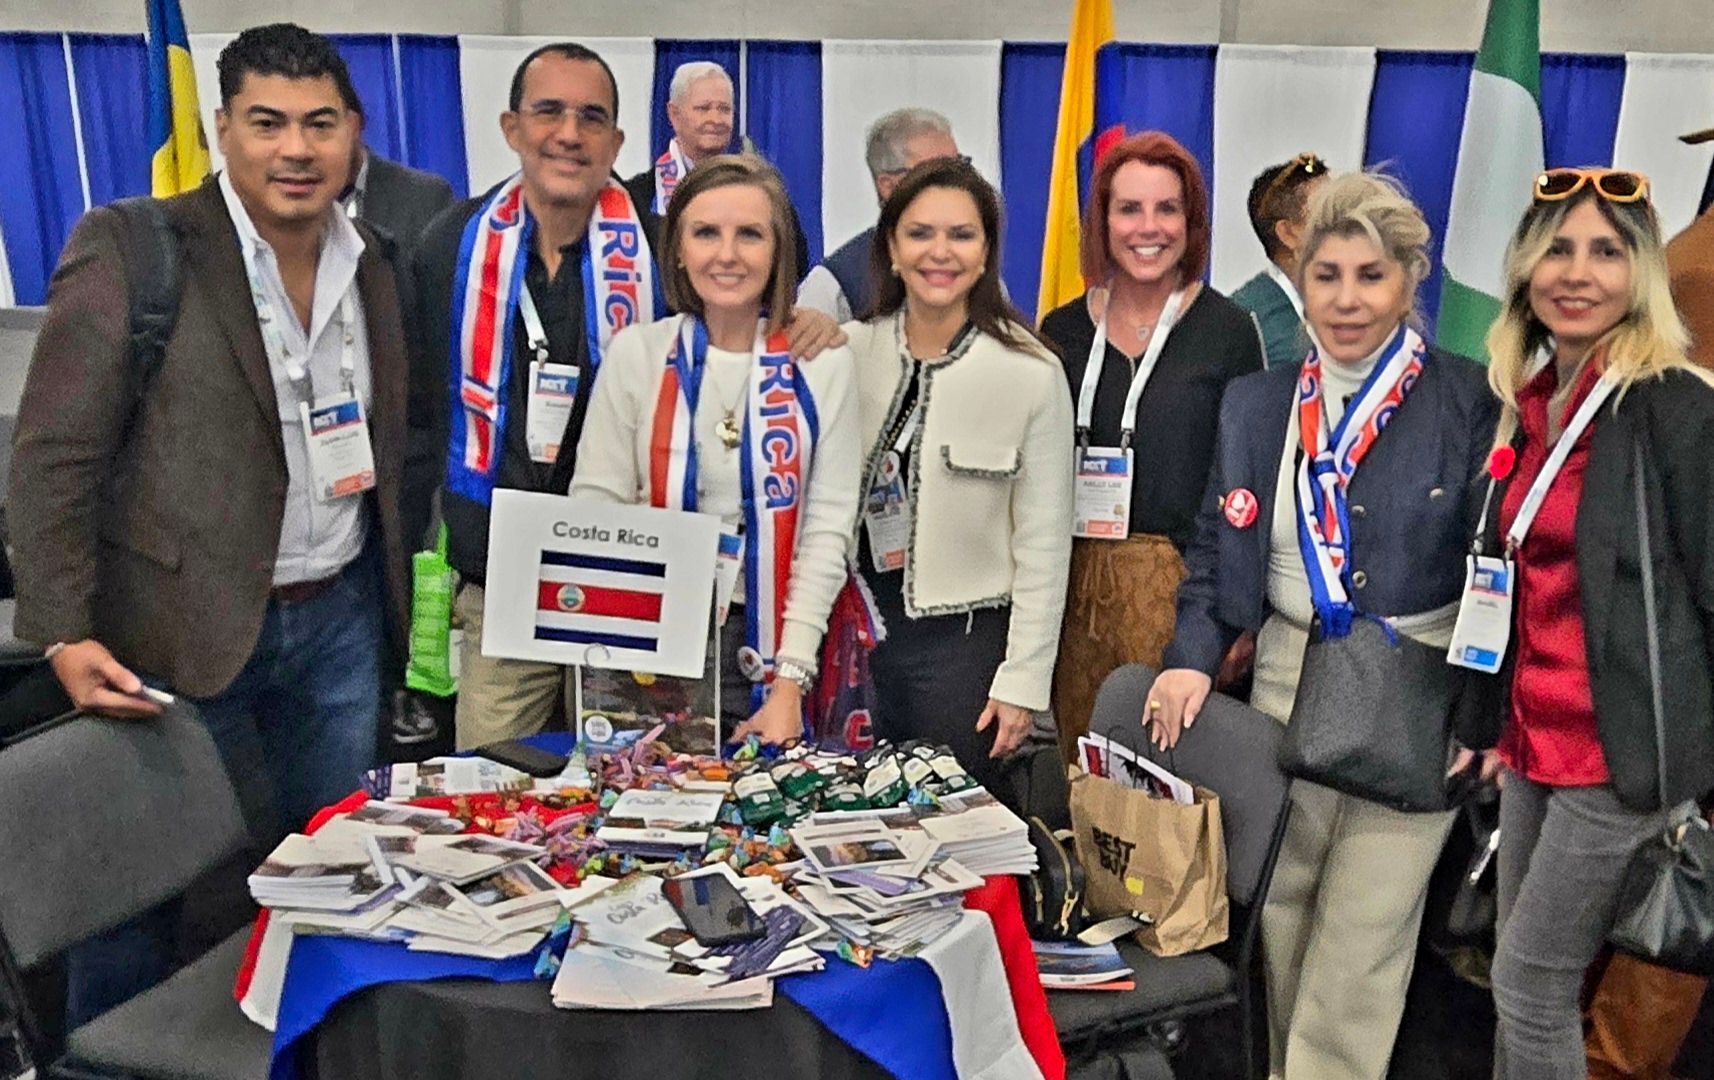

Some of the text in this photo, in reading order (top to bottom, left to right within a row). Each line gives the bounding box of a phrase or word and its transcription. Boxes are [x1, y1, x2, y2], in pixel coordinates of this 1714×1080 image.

[598, 221, 642, 328] Ric
[759, 355, 797, 509] Rica
[552, 520, 660, 548] Costa Rica
